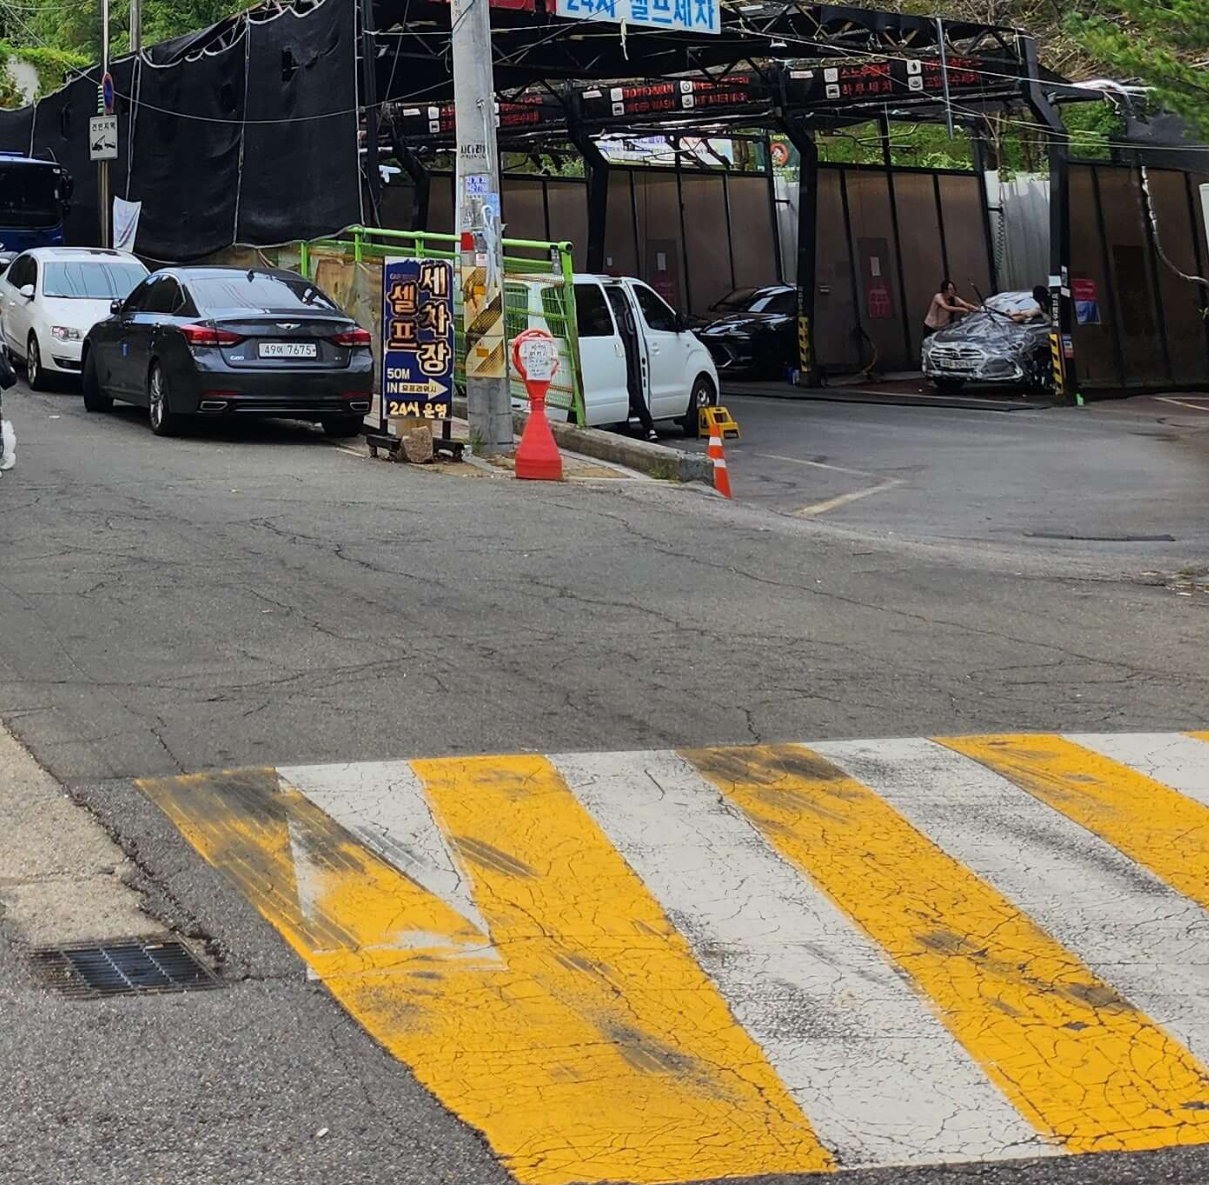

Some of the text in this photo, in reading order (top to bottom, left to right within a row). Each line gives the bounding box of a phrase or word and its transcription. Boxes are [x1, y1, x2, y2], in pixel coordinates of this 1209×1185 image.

[388, 283, 419, 350] 셀프
[420, 266, 449, 372] 세차장
[287, 345, 311, 355] 7675
[387, 368, 410, 380] 50M
[387, 382, 399, 394] IN
[389, 401, 448, 419] 24시 운영
